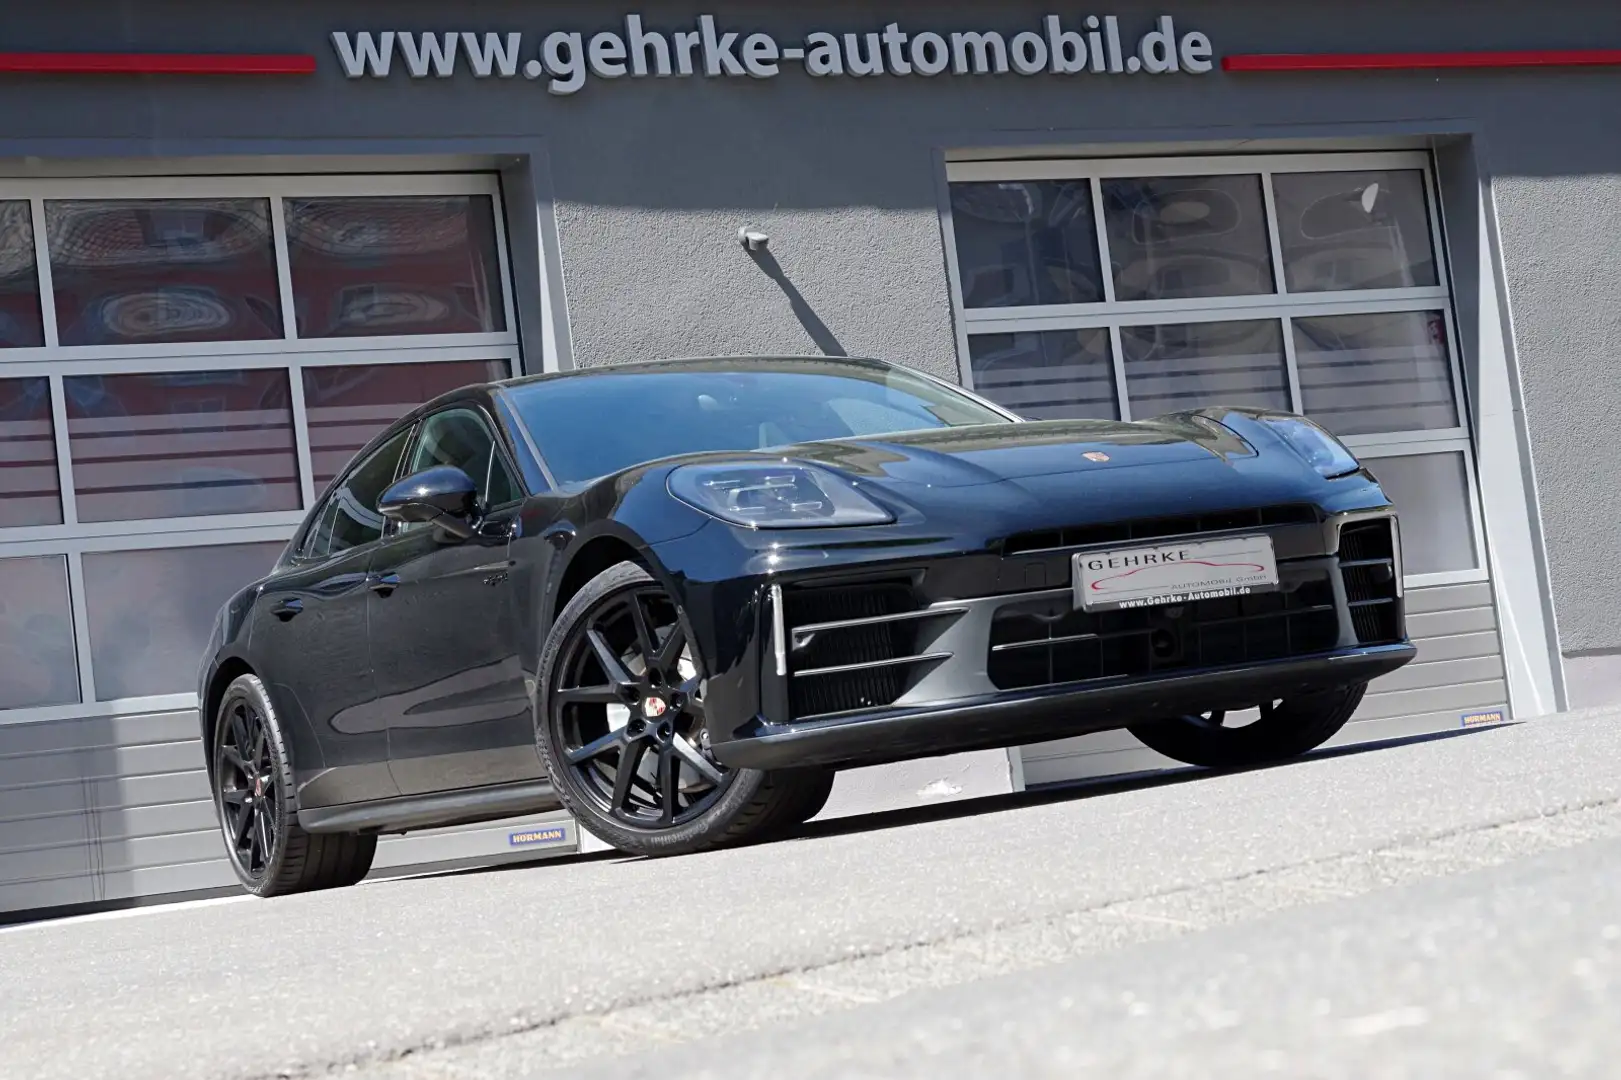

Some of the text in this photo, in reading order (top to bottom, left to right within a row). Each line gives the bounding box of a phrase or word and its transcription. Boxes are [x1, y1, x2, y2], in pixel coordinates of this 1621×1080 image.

[331, 15, 1214, 94] www.gehrke-automobil.de
[1088, 550, 1190, 571] GEHRKE
[1119, 587, 1250, 609] www.Gehrke-Automobil.de
